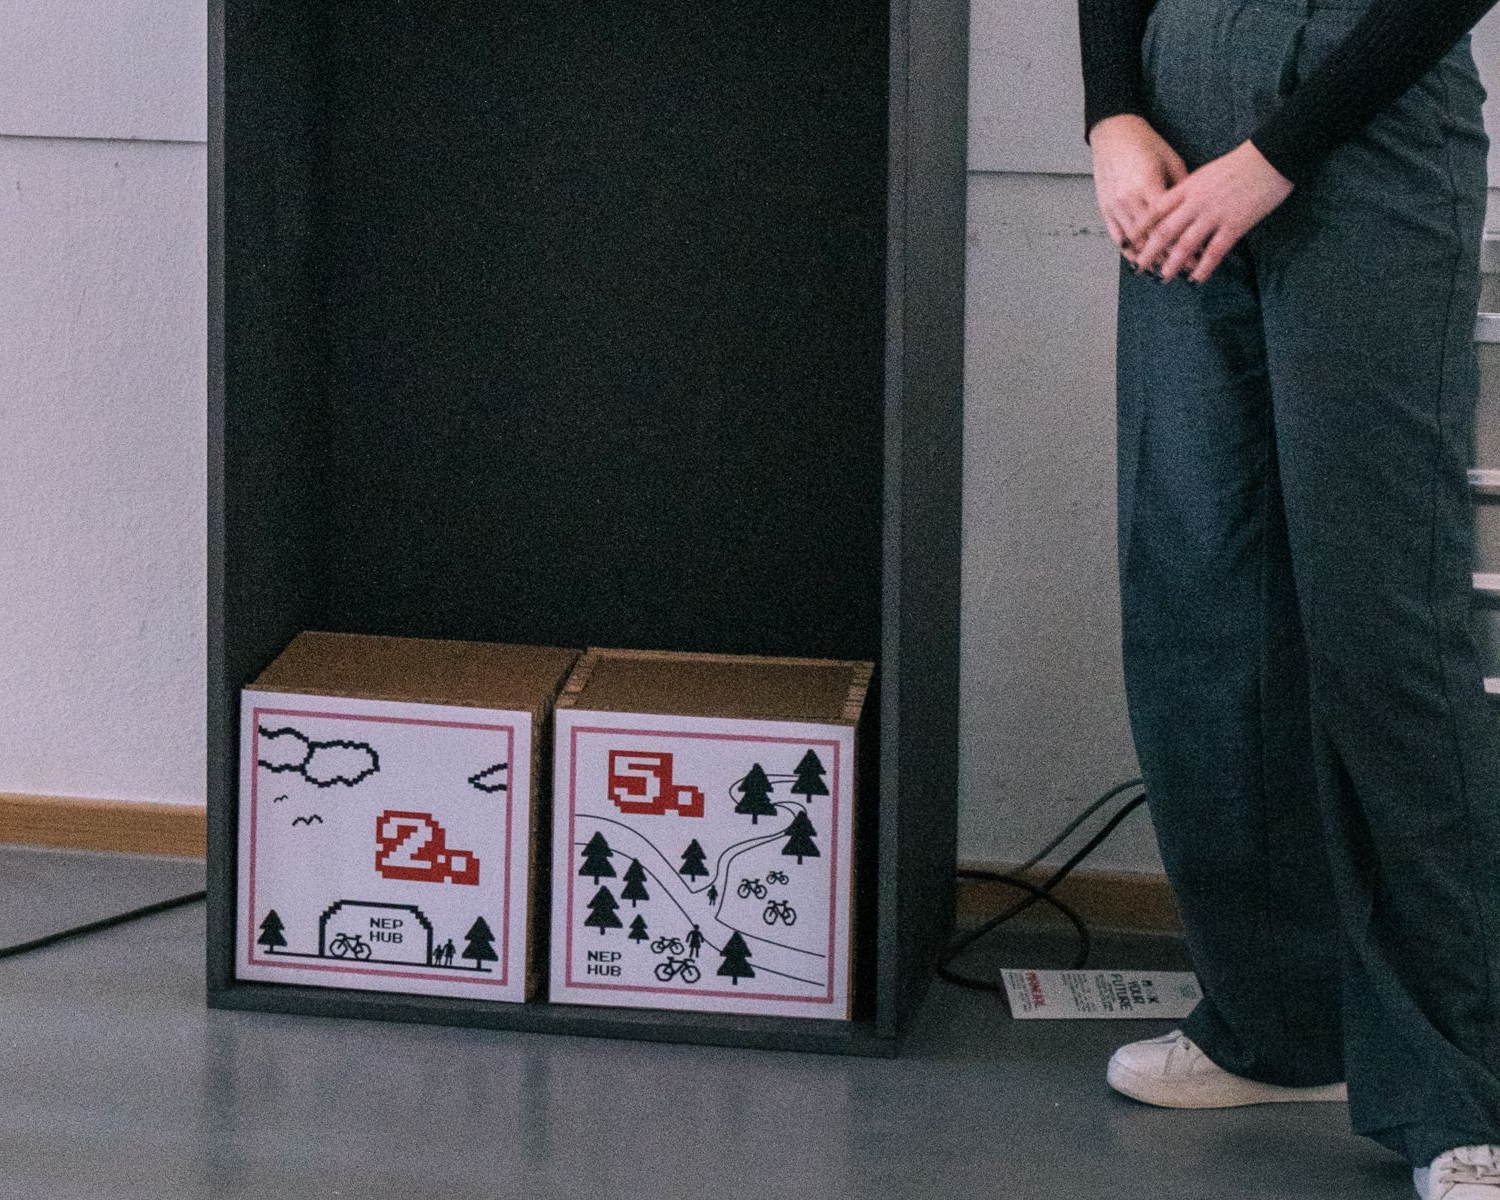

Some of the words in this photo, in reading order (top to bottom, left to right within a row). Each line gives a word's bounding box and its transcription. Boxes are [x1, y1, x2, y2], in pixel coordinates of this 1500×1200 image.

[369, 917, 404, 929] NEP
[369, 931, 404, 943] HUB
[587, 951, 622, 963] NEP
[587, 965, 622, 977] HUB
[1111, 973, 1134, 1011] FUTURE
